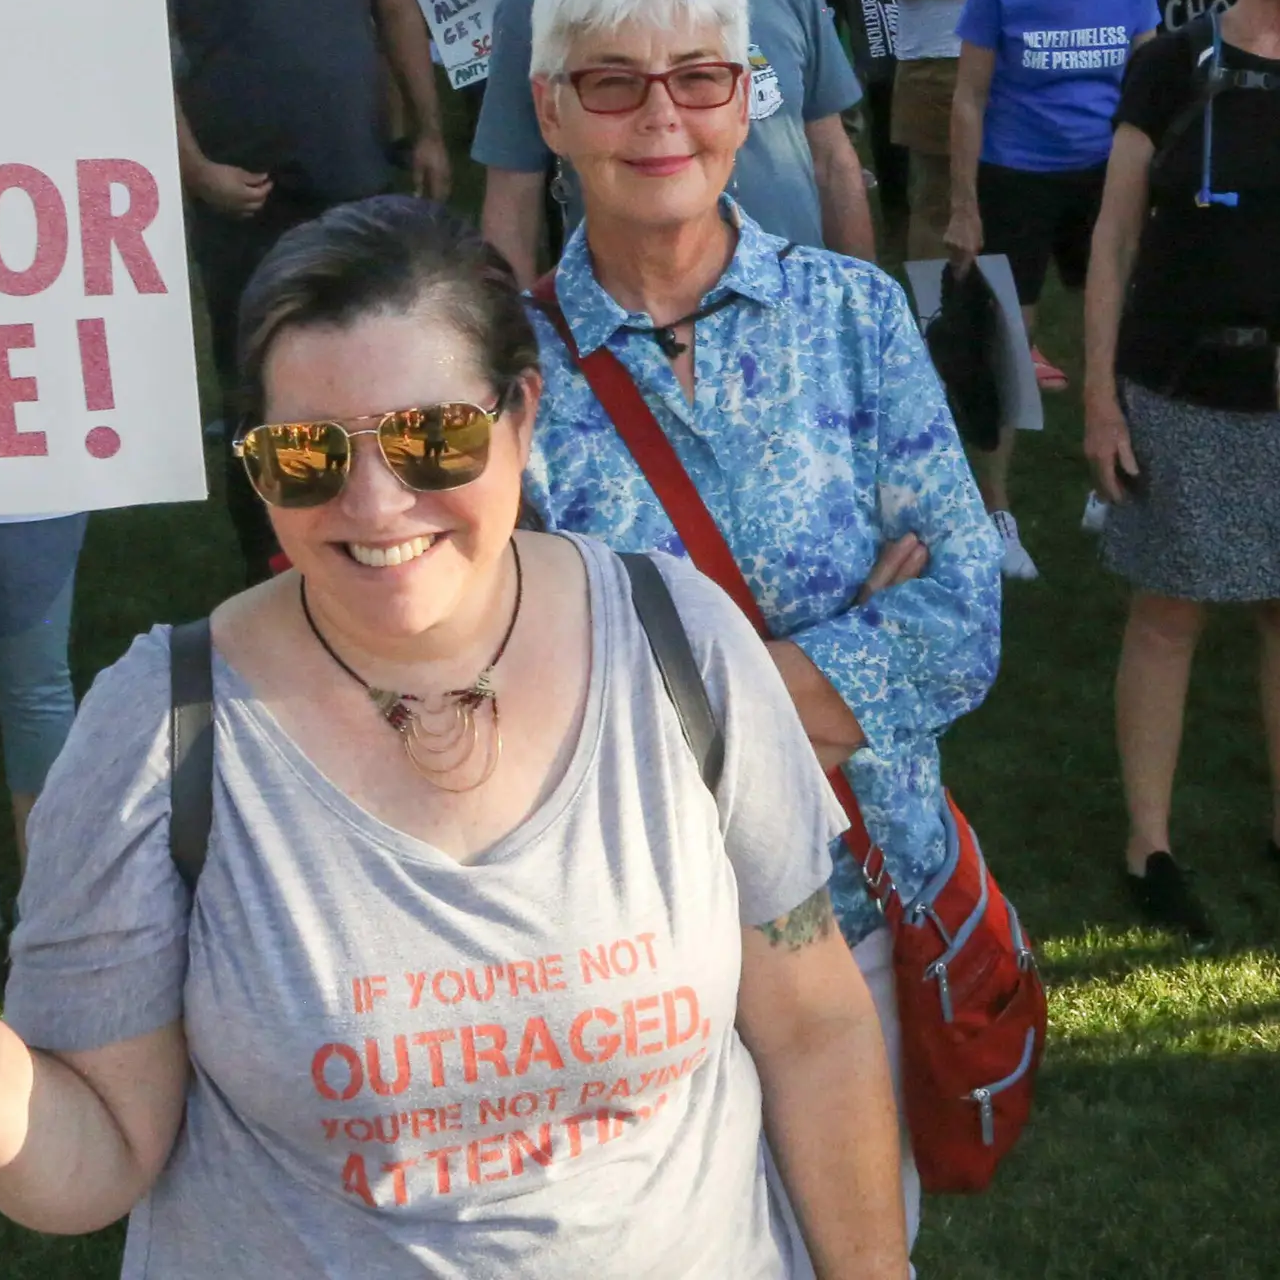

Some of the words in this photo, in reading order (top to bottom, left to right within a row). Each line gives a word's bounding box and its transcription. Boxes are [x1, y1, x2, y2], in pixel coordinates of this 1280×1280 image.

[1022, 48, 1050, 70] SHE
[352, 976, 387, 1014] IF
[404, 953, 566, 1010] YOU'RE
[579, 932, 658, 985] NOT
[310, 985, 710, 1101] OUTRAGED,
[320, 1102, 463, 1144] YOU'RE
[479, 1087, 566, 1126] NOT
[580, 1047, 708, 1107] PAYING
